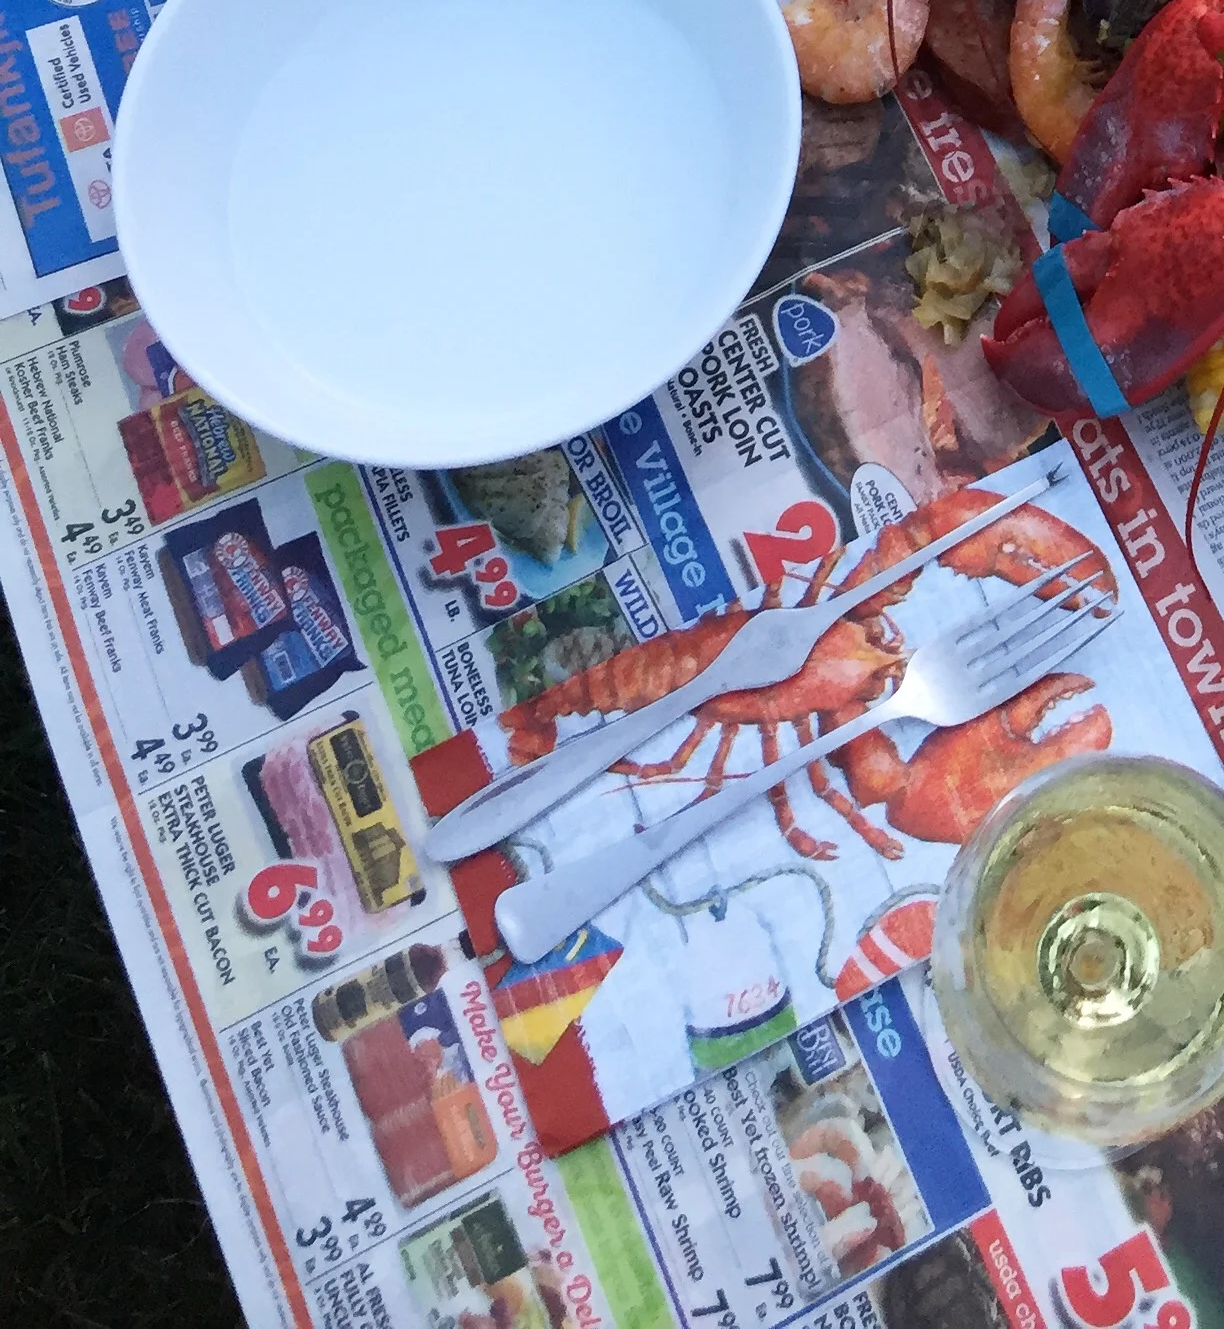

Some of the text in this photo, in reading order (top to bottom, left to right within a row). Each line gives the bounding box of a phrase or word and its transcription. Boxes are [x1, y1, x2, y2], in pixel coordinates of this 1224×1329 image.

[48, 56, 75, 109] Certified
[56, 22, 92, 104] Used Vehicles
[67, 339, 93, 388] Plumrose
[739, 316, 776, 373] FRESH
[780, 298, 827, 355] pork
[13, 360, 56, 460] Kosher Beef Franks
[26, 356, 64, 443] Hebrew National
[55, 345, 84, 405] Ham Steaks
[715, 327, 790, 465] CENTER CUT
[721, 407, 763, 469] LOIN
[380, 493, 409, 543] FILLETS
[582, 468, 635, 547] BROIL
[622, 439, 716, 594] Village
[1110, 502, 1182, 579] in
[92, 563, 115, 600] Kayem
[133, 543, 157, 581] Kayem
[313, 480, 408, 661] packaged
[78, 569, 123, 673] Fenway Beef Franks
[121, 549, 165, 655] Fenway Meat Franks
[439, 649, 465, 692] TUNA
[455, 641, 493, 717] BONELESS
[171, 783, 220, 887] STEAKHOUSE
[189, 774, 237, 875] PETER LUGER
[155, 790, 237, 985] EXTRA THICK CUT BACON
[261, 945, 284, 974] EA.
[453, 979, 508, 1065] Make
[278, 1004, 334, 1134] Old Fashioned Sauce
[291, 997, 354, 1141] Peter Luger Steakhouse
[479, 1061, 535, 1144] Your
[944, 1051, 969, 1087] USDA
[658, 1133, 685, 1176] COUNT
[680, 1088, 747, 1221] ooked Shrimp
[709, 1105, 735, 1148] COUNT
[720, 1065, 791, 1208] Best Yet frozen
[503, 1139, 576, 1252] Burger
[640, 1140, 711, 1283] Peel Raw Shrimp
[1004, 1140, 1055, 1209] RIBS
[553, 1248, 576, 1271] a
[984, 1239, 1025, 1299] usda
